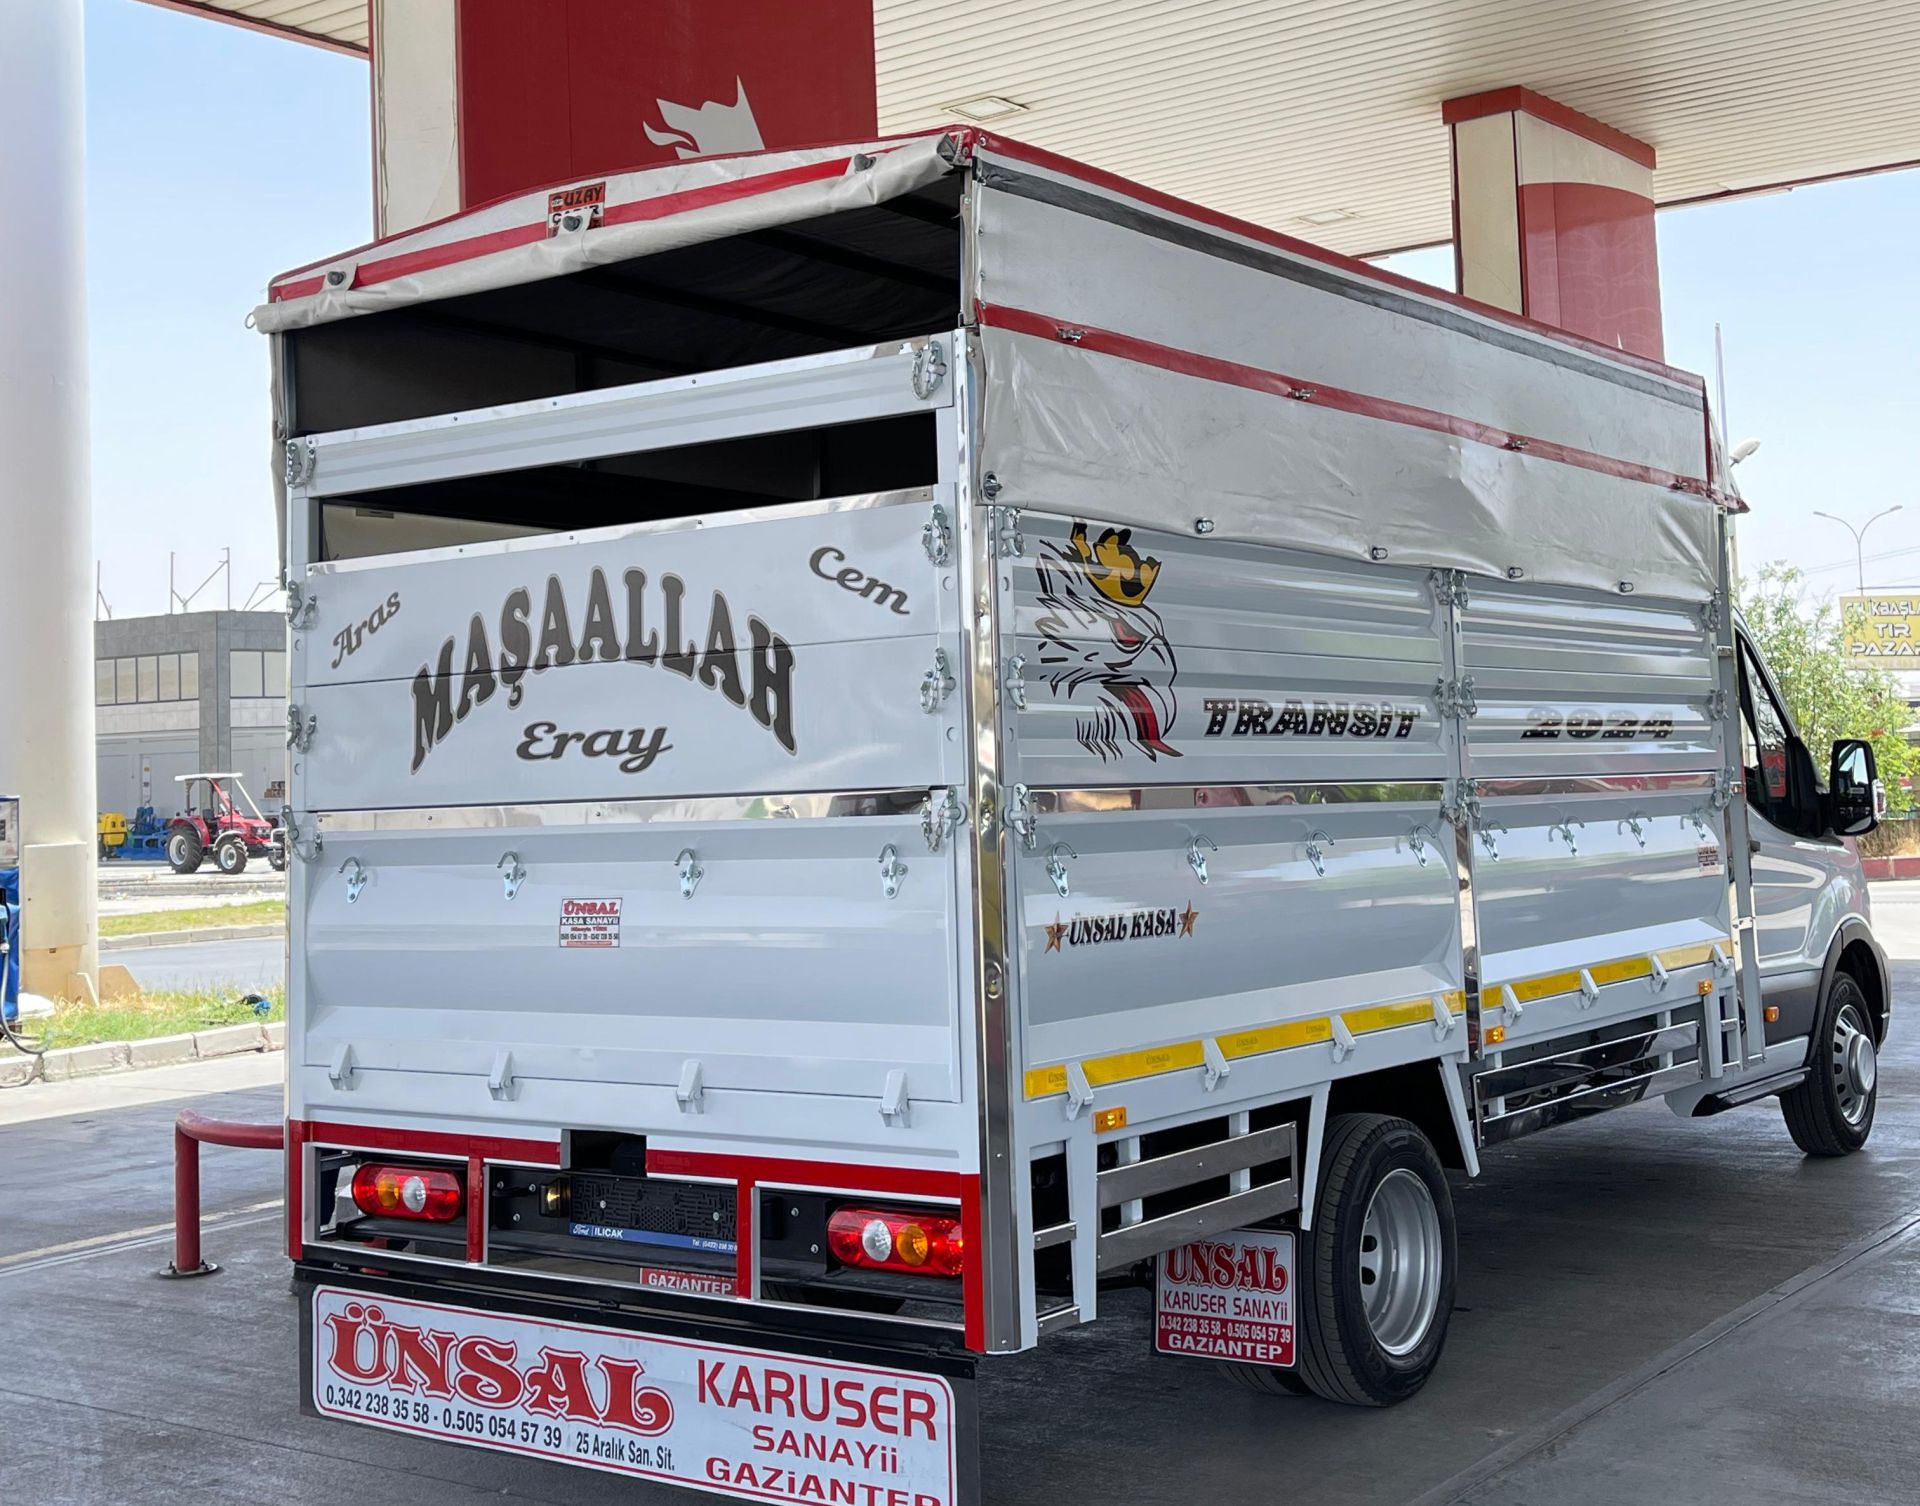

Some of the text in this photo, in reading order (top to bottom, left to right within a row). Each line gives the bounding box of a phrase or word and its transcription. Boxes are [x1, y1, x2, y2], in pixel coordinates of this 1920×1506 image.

[808, 545, 911, 615] Cem
[330, 591, 401, 669] Aras
[1873, 623, 1911, 638] TIR
[410, 565, 798, 775] MAŞAALLAH
[1520, 707, 1674, 739] 2024
[516, 721, 673, 773] Eray
[561, 917, 584, 925] KASA
[564, 901, 618, 916] ÜNSAL
[1069, 908, 1176, 946] ÜNSAL KASA
[573, 1224, 590, 1235] Ford
[1164, 1290, 1227, 1315] KARUSER
[1160, 1315, 1181, 1331] 0.342
[1199, 1319, 1209, 1334] 35
[1210, 1321, 1221, 1336] 58
[1251, 1325, 1266, 1341] 054
[1268, 1327, 1279, 1342] 57
[1280, 1329, 1291, 1344] 39
[324, 1303, 674, 1437] ÜNSAL
[326, 1384, 364, 1411] 0.342
[365, 1392, 389, 1416] 238
[392, 1398, 409, 1419] 35
[412, 1402, 430, 1424] 58
[443, 1407, 484, 1434] 0.505
[488, 1417, 516, 1440] 054
[521, 1423, 539, 1444] 57
[544, 1426, 562, 1449] 39
[697, 1359, 937, 1441] KARUSER
[576, 1432, 675, 1471] 25 Aralık San. Sit.
